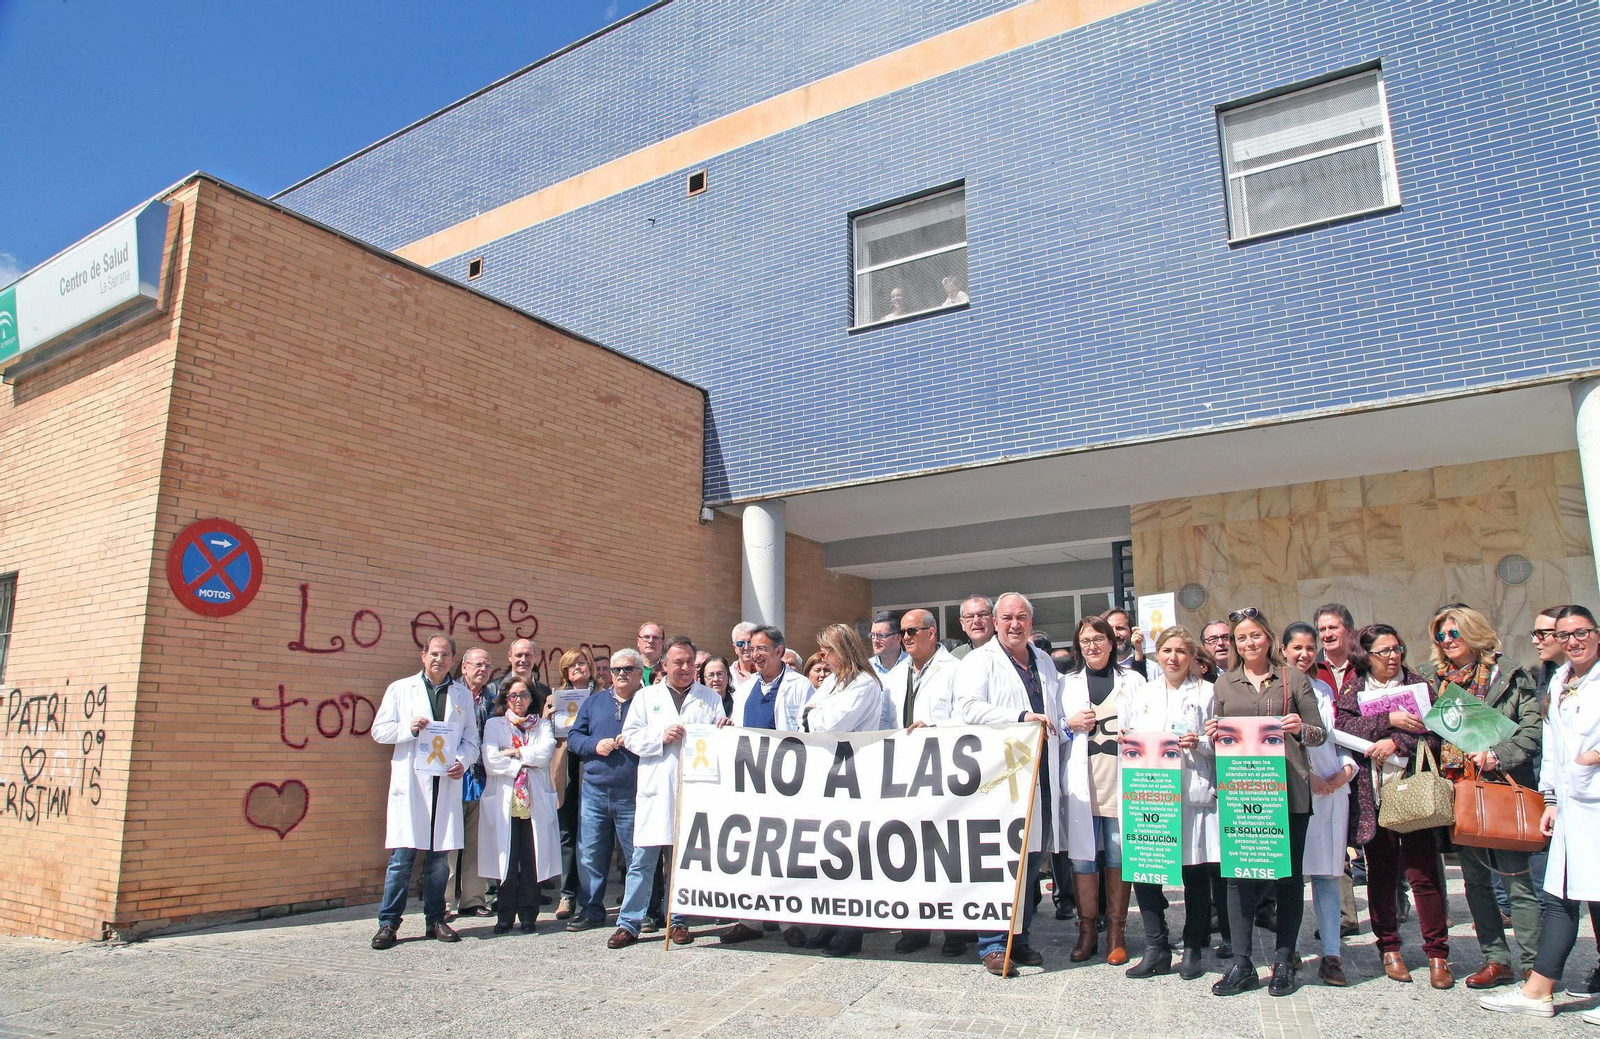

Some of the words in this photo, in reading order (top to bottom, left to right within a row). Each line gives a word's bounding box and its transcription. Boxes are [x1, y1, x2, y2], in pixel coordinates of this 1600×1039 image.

[60, 270, 88, 296] Centro
[90, 260, 101, 280] de
[103, 241, 129, 273] Salud
[99, 281, 108, 295] La
[107, 270, 131, 291] Serrana
[198, 588, 231, 600] MOTOS
[410, 598, 539, 649] eres
[6, 687, 68, 736] PATRI
[84, 684, 108, 724] 09
[82, 729, 106, 768] 09
[734, 735, 807, 797] NO
[823, 740, 862, 800] A
[880, 734, 983, 799] LAS
[0, 782, 71, 826] RISTIAN
[1244, 804, 1262, 814] NO
[1144, 813, 1160, 822] NO
[1138, 834, 1177, 843] SOLUCIÓN
[1238, 826, 1284, 835] SOLUCIÓN
[1133, 872, 1168, 884] SATSE
[1234, 868, 1275, 879] SATSE
[676, 888, 803, 914] SINDICATO
[811, 897, 910, 920] MEDICO
[919, 902, 954, 920] DE
